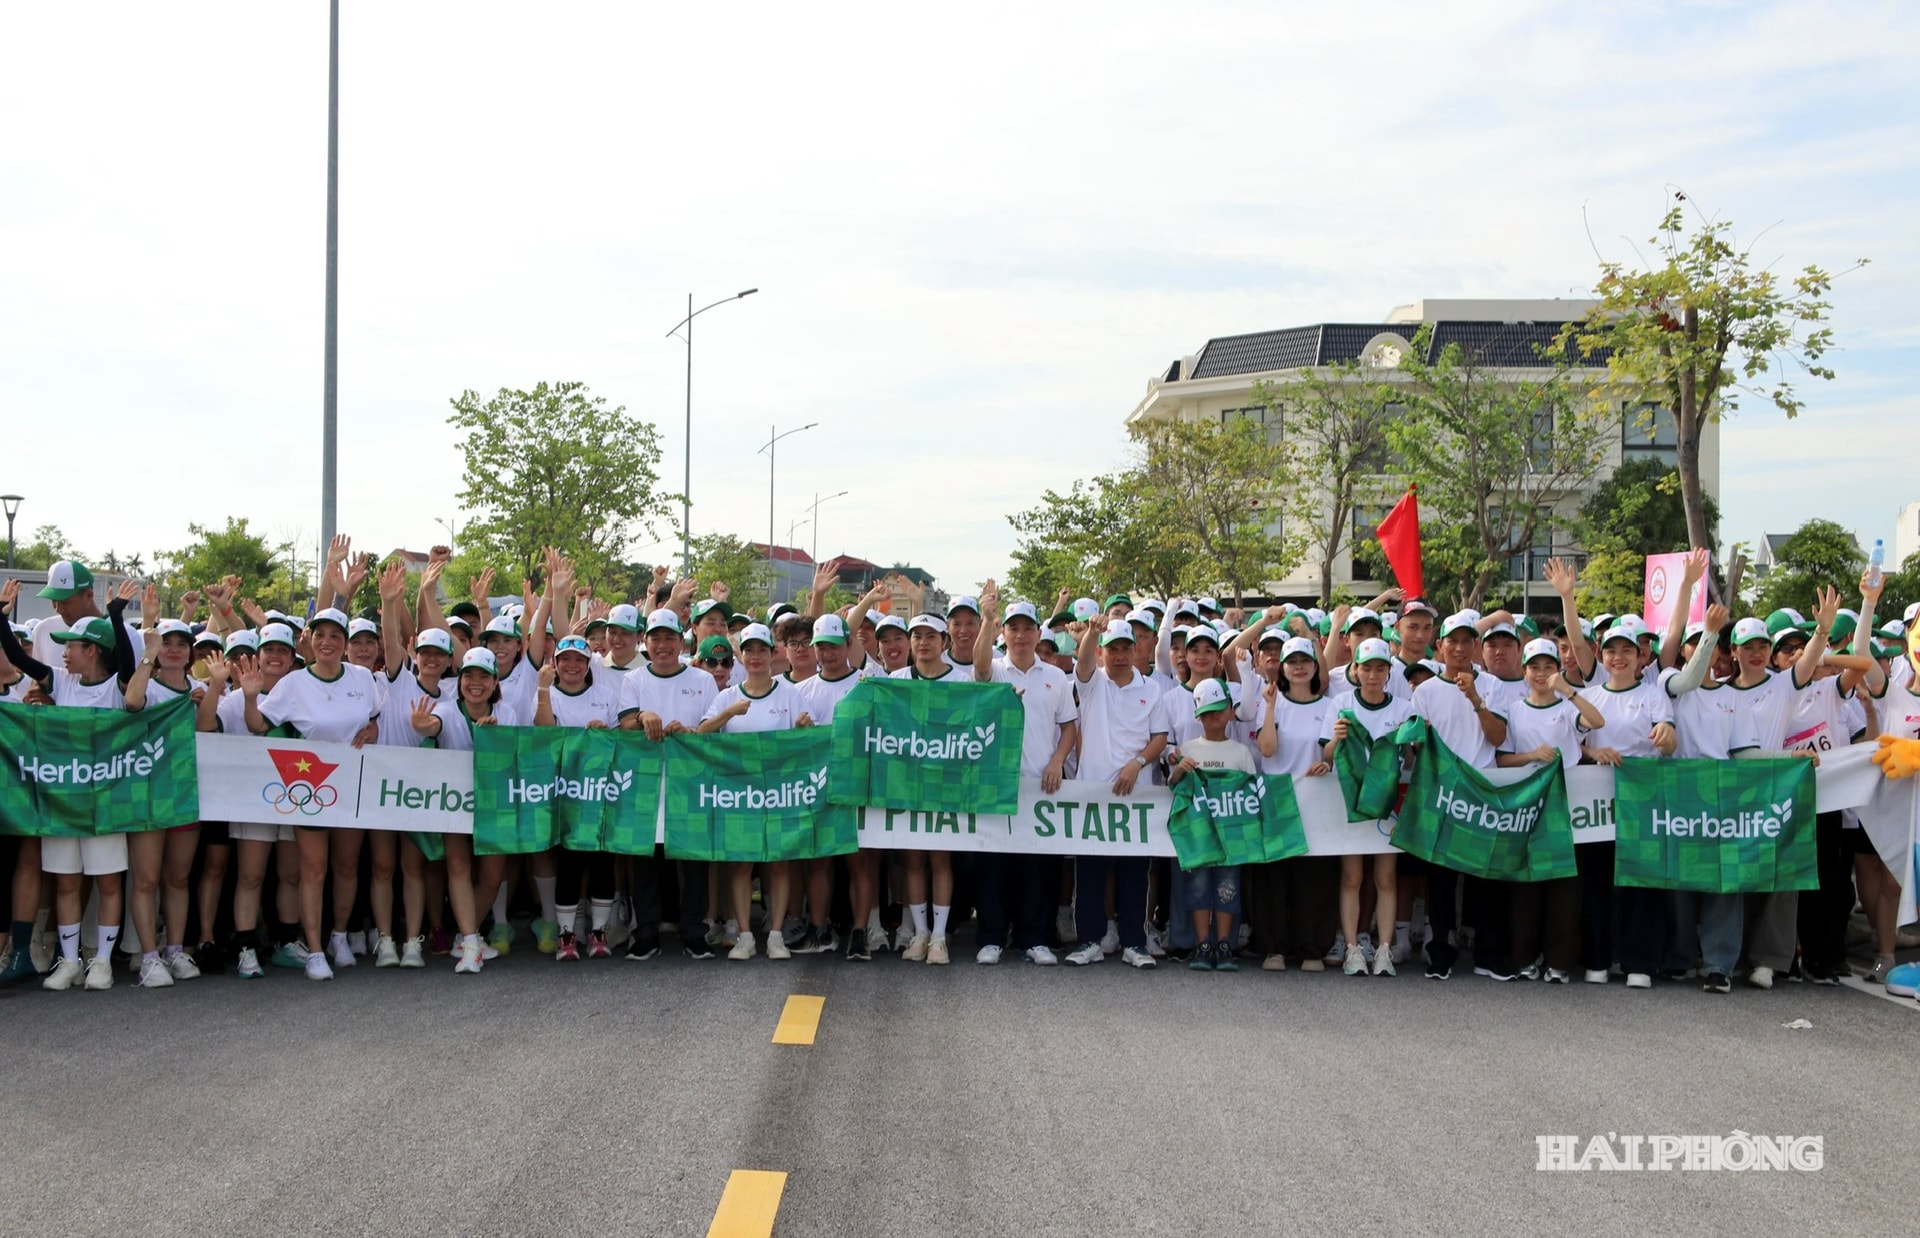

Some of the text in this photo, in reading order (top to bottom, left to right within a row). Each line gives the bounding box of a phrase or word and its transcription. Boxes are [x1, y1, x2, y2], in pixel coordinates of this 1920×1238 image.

[864, 725, 984, 760] Herbalife
[18, 750, 153, 784] Herbalife
[508, 775, 620, 803] Herbalife
[699, 780, 817, 809] Herbalife
[1033, 800, 1155, 844] START
[1436, 785, 1540, 833] Herbalif
[1651, 808, 1781, 839] Herbalife
